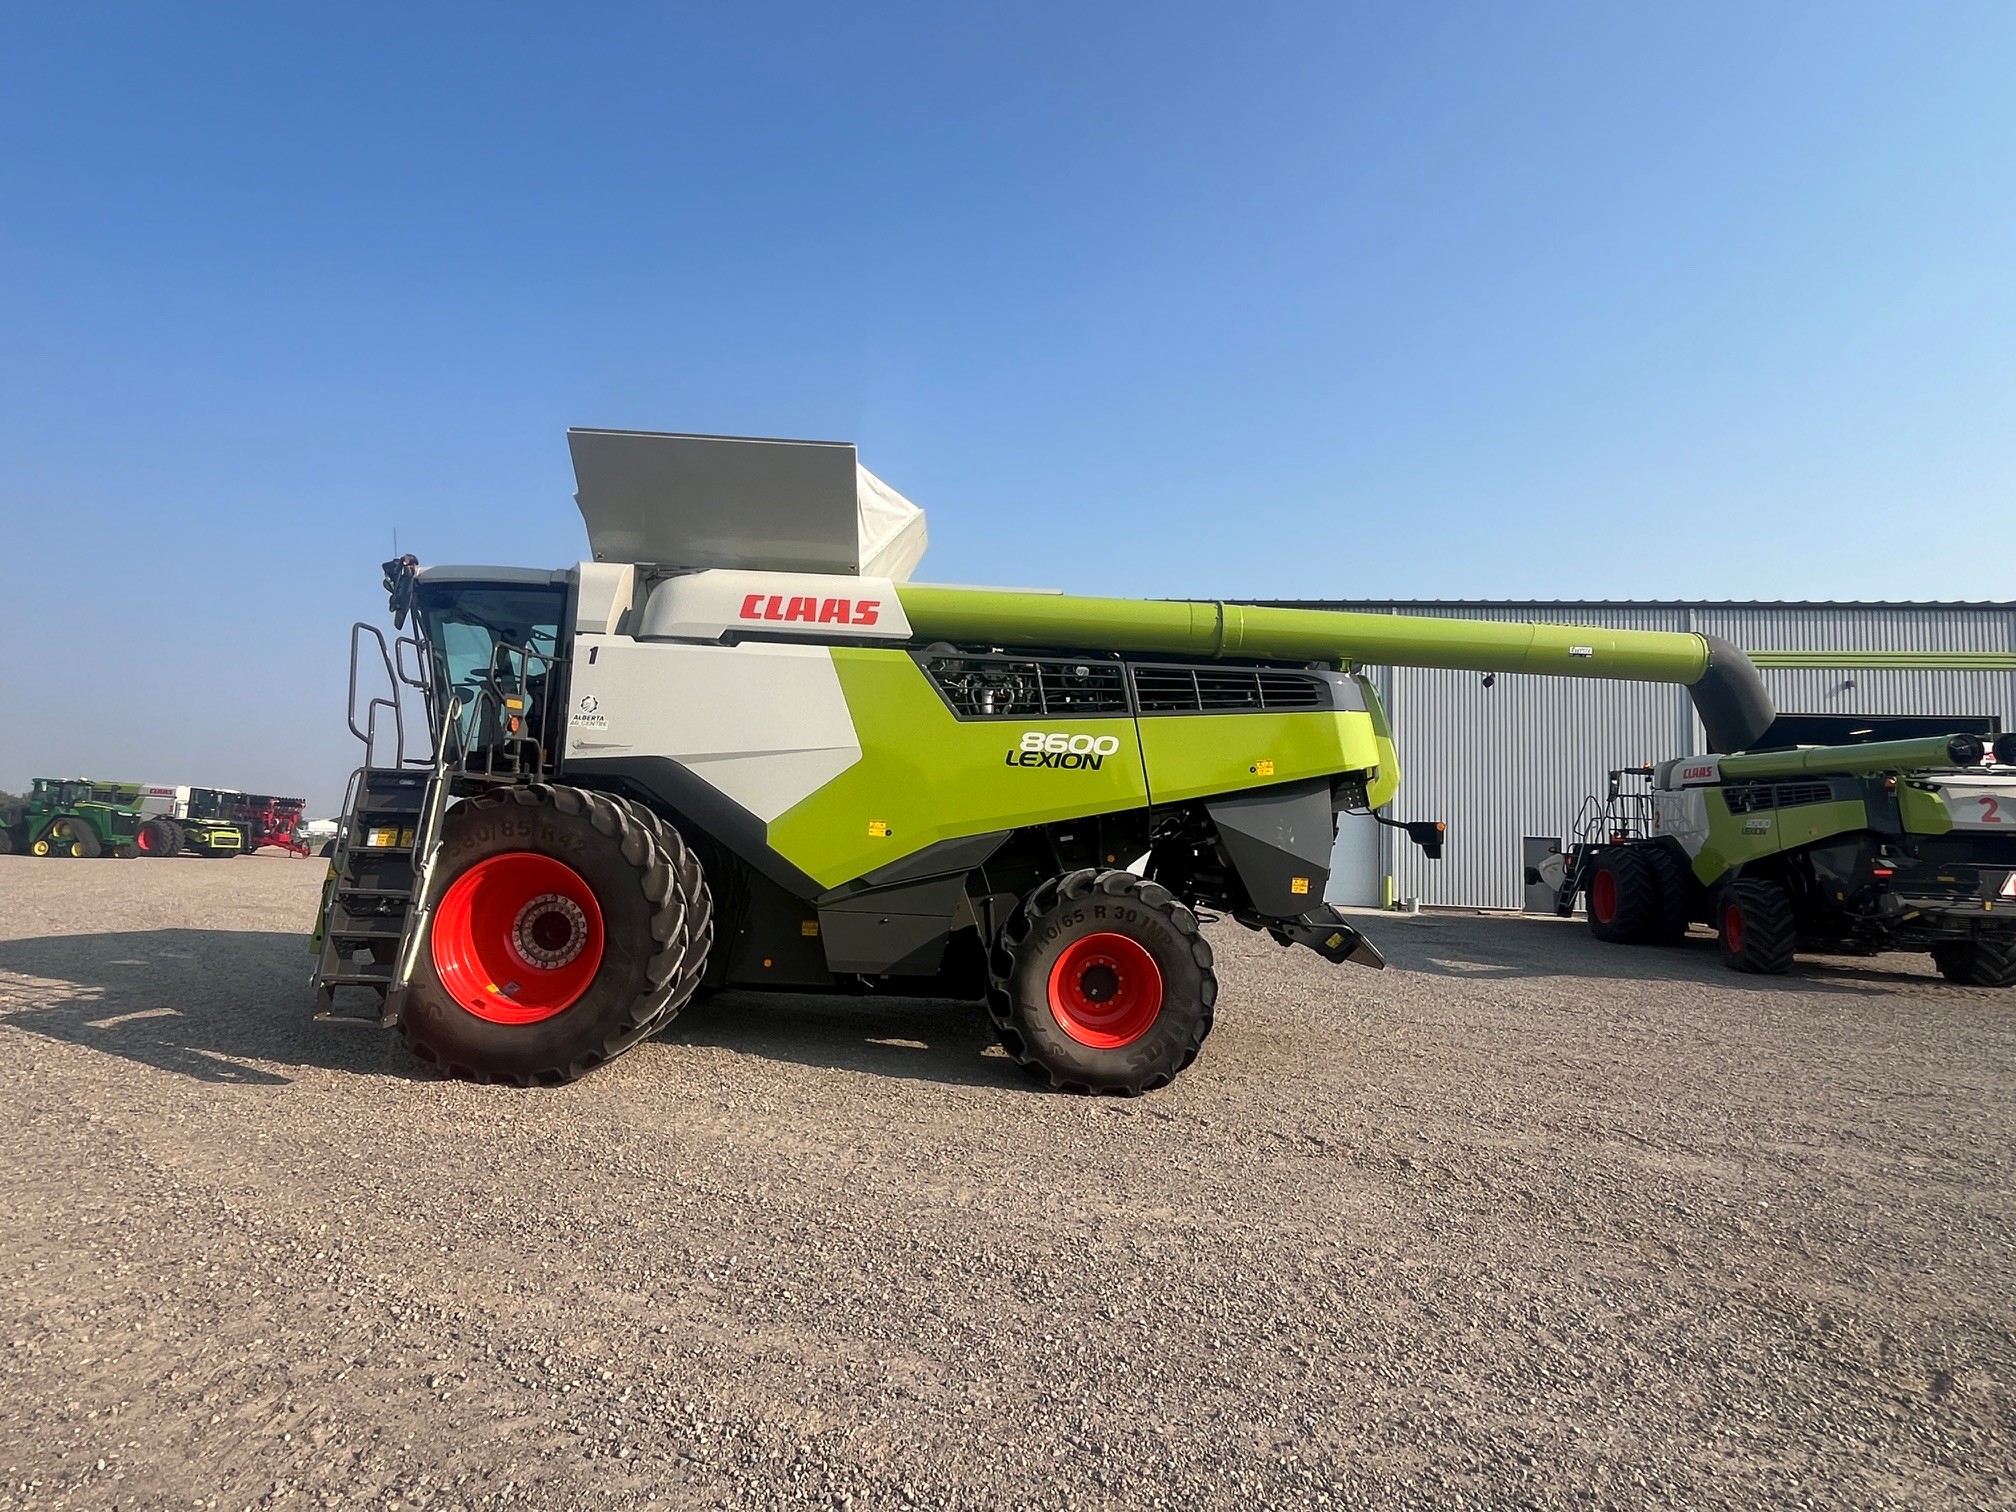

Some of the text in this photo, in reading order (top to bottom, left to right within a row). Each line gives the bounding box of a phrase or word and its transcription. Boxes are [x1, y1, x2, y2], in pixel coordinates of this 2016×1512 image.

[739, 594, 881, 625] CLAAS
[588, 645, 599, 665] 1
[1019, 731, 1120, 756] 8600
[1005, 750, 1104, 770] LEXION
[1683, 766, 1713, 779] CLAAS
[1654, 810, 1661, 829] 2
[1979, 797, 2001, 823] 2
[1033, 908, 1086, 957] 710/65
[1094, 904, 1107, 919] R
[1114, 905, 1138, 923] 30
